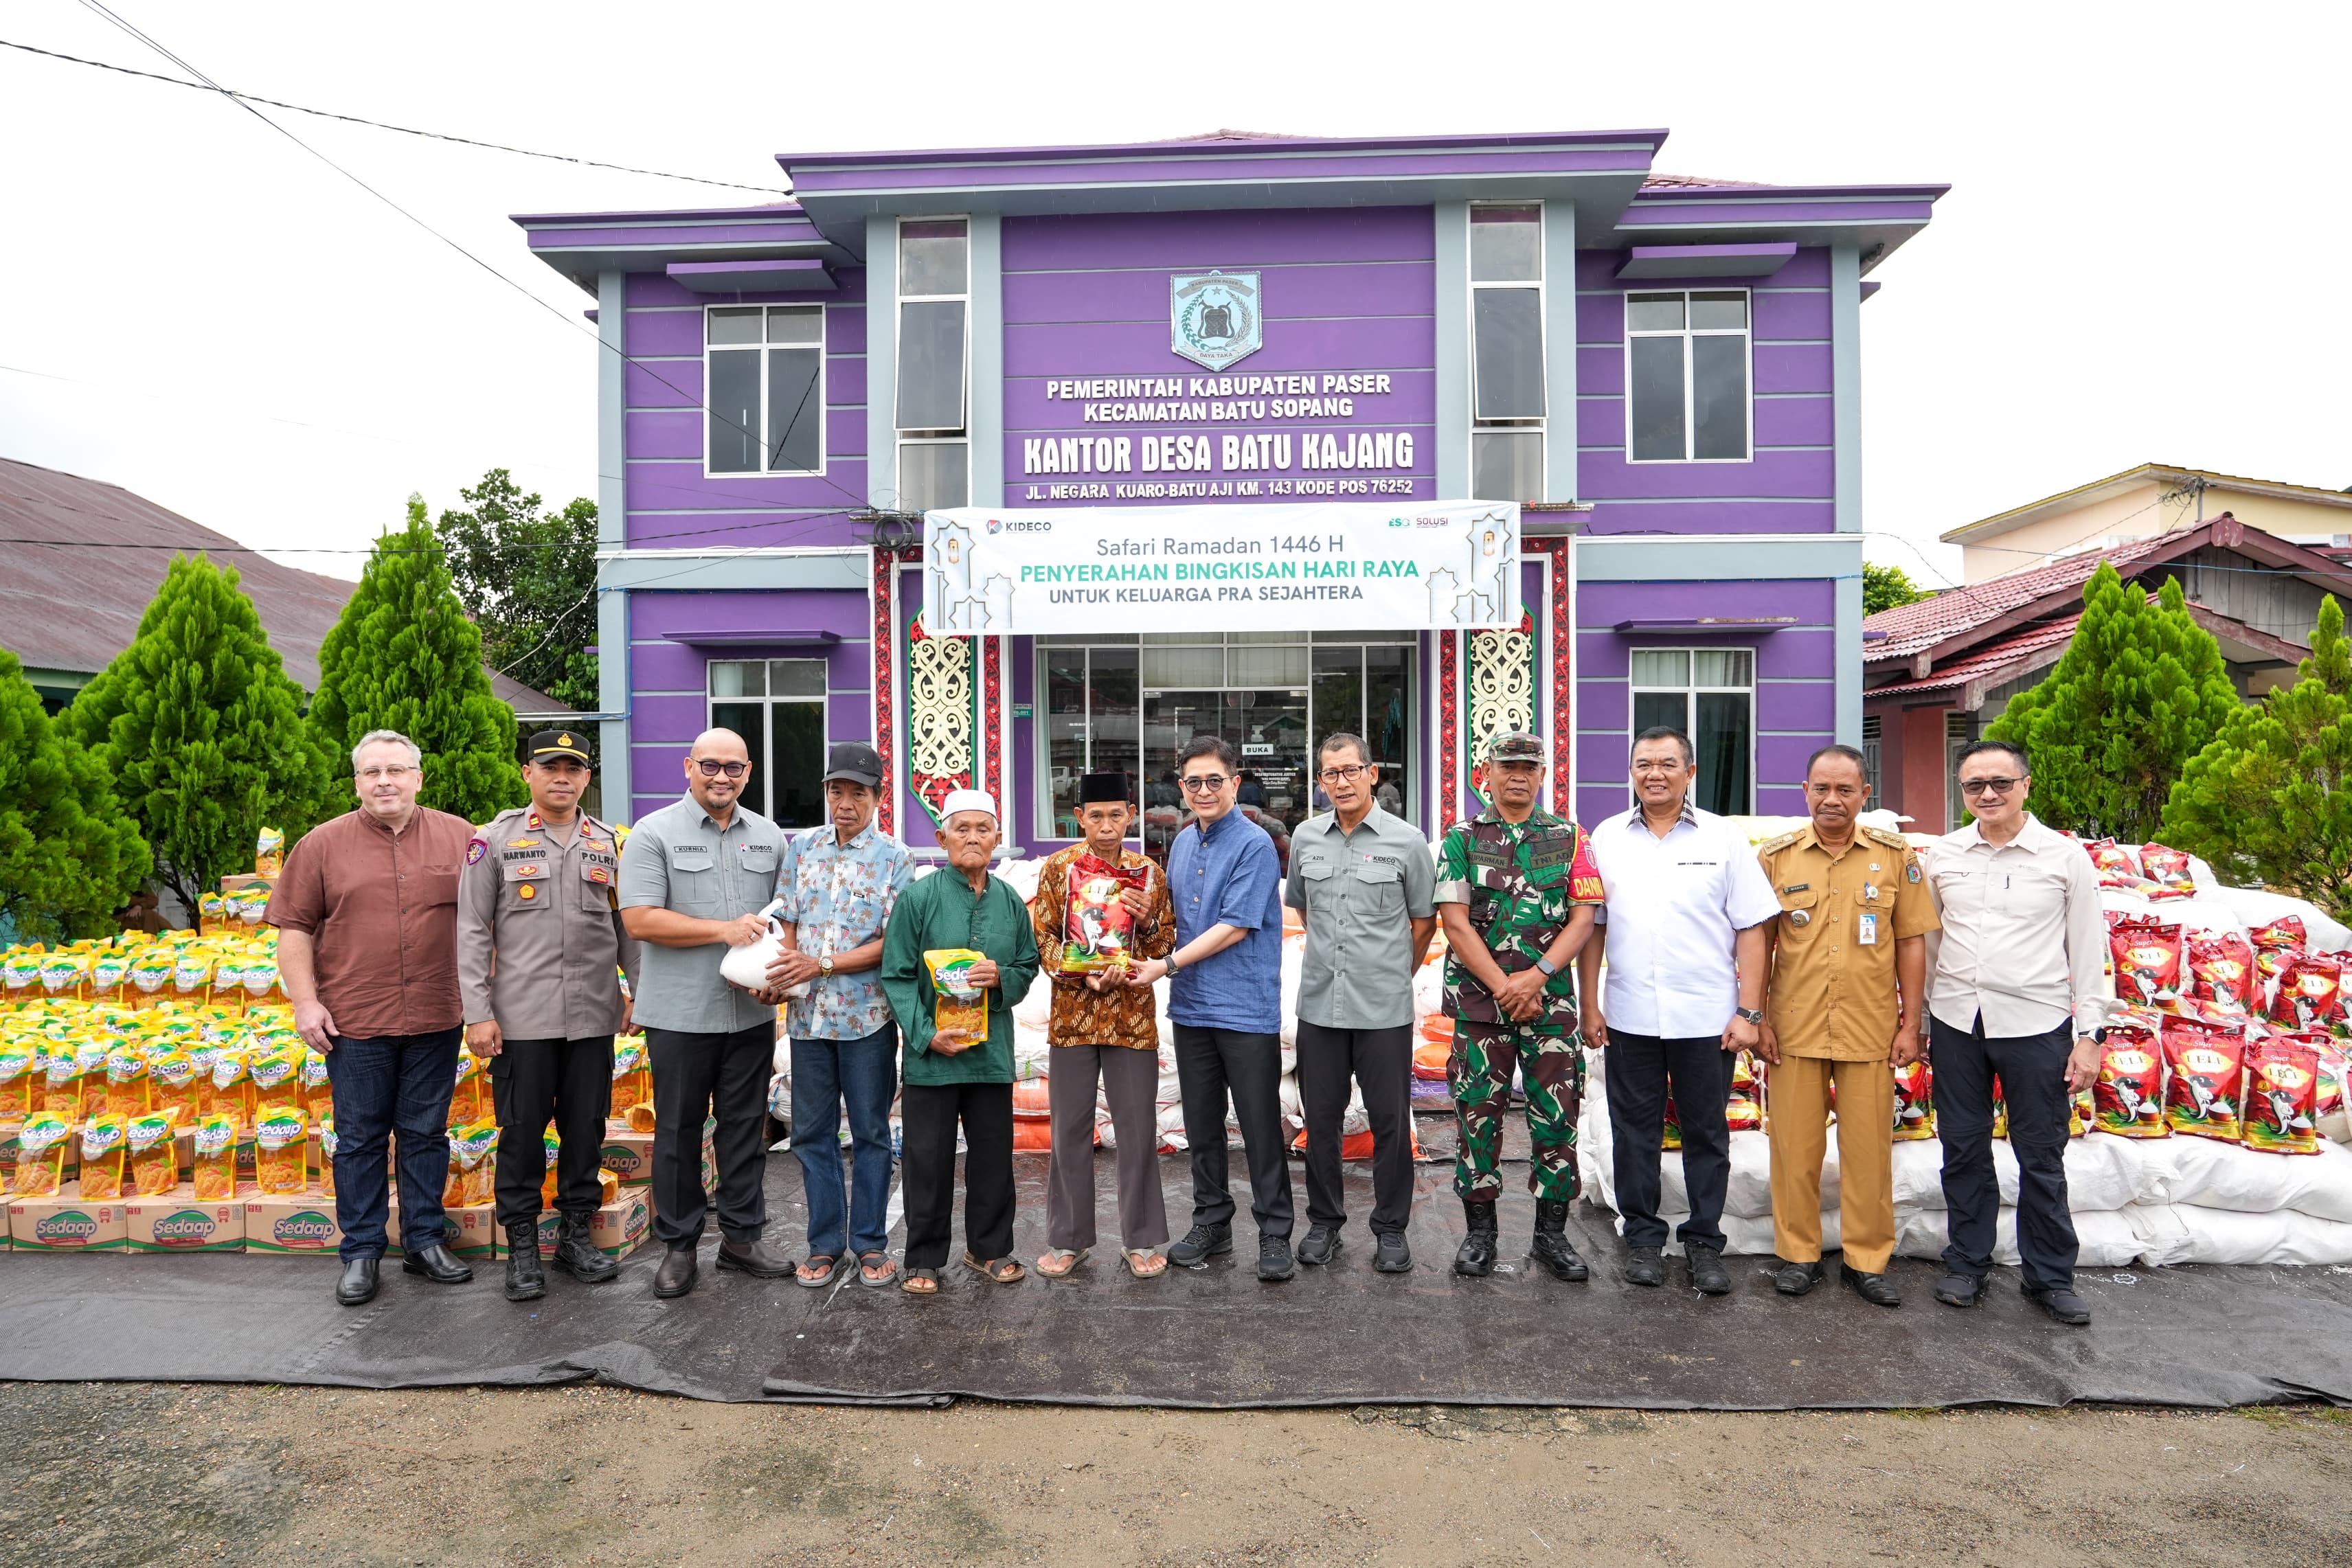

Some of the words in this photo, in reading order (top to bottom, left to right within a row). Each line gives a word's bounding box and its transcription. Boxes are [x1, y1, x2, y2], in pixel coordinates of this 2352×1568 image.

[1191, 278, 1221, 287] KABUPATEN
[1048, 378, 1182, 399] PEMERINTAH
[1190, 376, 1315, 396] KABUPATEN
[1323, 374, 1391, 394] PASER
[1084, 402, 1206, 422] KECAMATAN
[1211, 400, 1265, 420] BATU
[1271, 398, 1353, 418] SOPANG
[1024, 437, 1131, 474] KANTOR
[1142, 435, 1211, 472] DESA
[1222, 433, 1291, 470] BATU
[1302, 433, 1413, 469] KAJANG
[1026, 486, 1047, 500] JL.
[1050, 484, 1109, 499] NEGARA
[1116, 483, 1206, 498] KUARO-BATU
[1209, 483, 1232, 497] AJI
[1237, 481, 1263, 496] KM.
[1268, 481, 1291, 495] 143
[1296, 481, 1335, 495] KODE
[1339, 480, 1368, 494] POS
[1371, 480, 1413, 494] 76252
[1006, 522, 1051, 531] KIDECO
[1097, 538, 1155, 556] Safari
[1164, 536, 1261, 555] Ramadan
[1270, 535, 1320, 553] 1446
[1329, 535, 1343, 552] H
[1021, 563, 1168, 582] PENYERAHAN
[1175, 561, 1296, 580] BINGKISAN
[1304, 560, 1355, 578] HARI
[1363, 560, 1420, 578] RAYA
[1050, 589, 1110, 604] UNTUK
[1116, 587, 1212, 602] KELUARGA
[1218, 587, 1253, 601] PRA
[1258, 585, 1364, 600] SEJAHTERA
[504, 850, 546, 861] HARWANTO
[582, 852, 613, 865] POLRI
[1373, 856, 1396, 864] KIDECO
[1534, 856, 1552, 865] TNI
[2298, 966, 2319, 974] Super
[2113, 1041, 2134, 1049] Super
[2270, 1054, 2289, 1063] Super
[602, 1153, 641, 1172] daap
[36, 1217, 98, 1237] Sedaap
[153, 1217, 215, 1237] Sedaap
[274, 1218, 335, 1240] Sedaap
